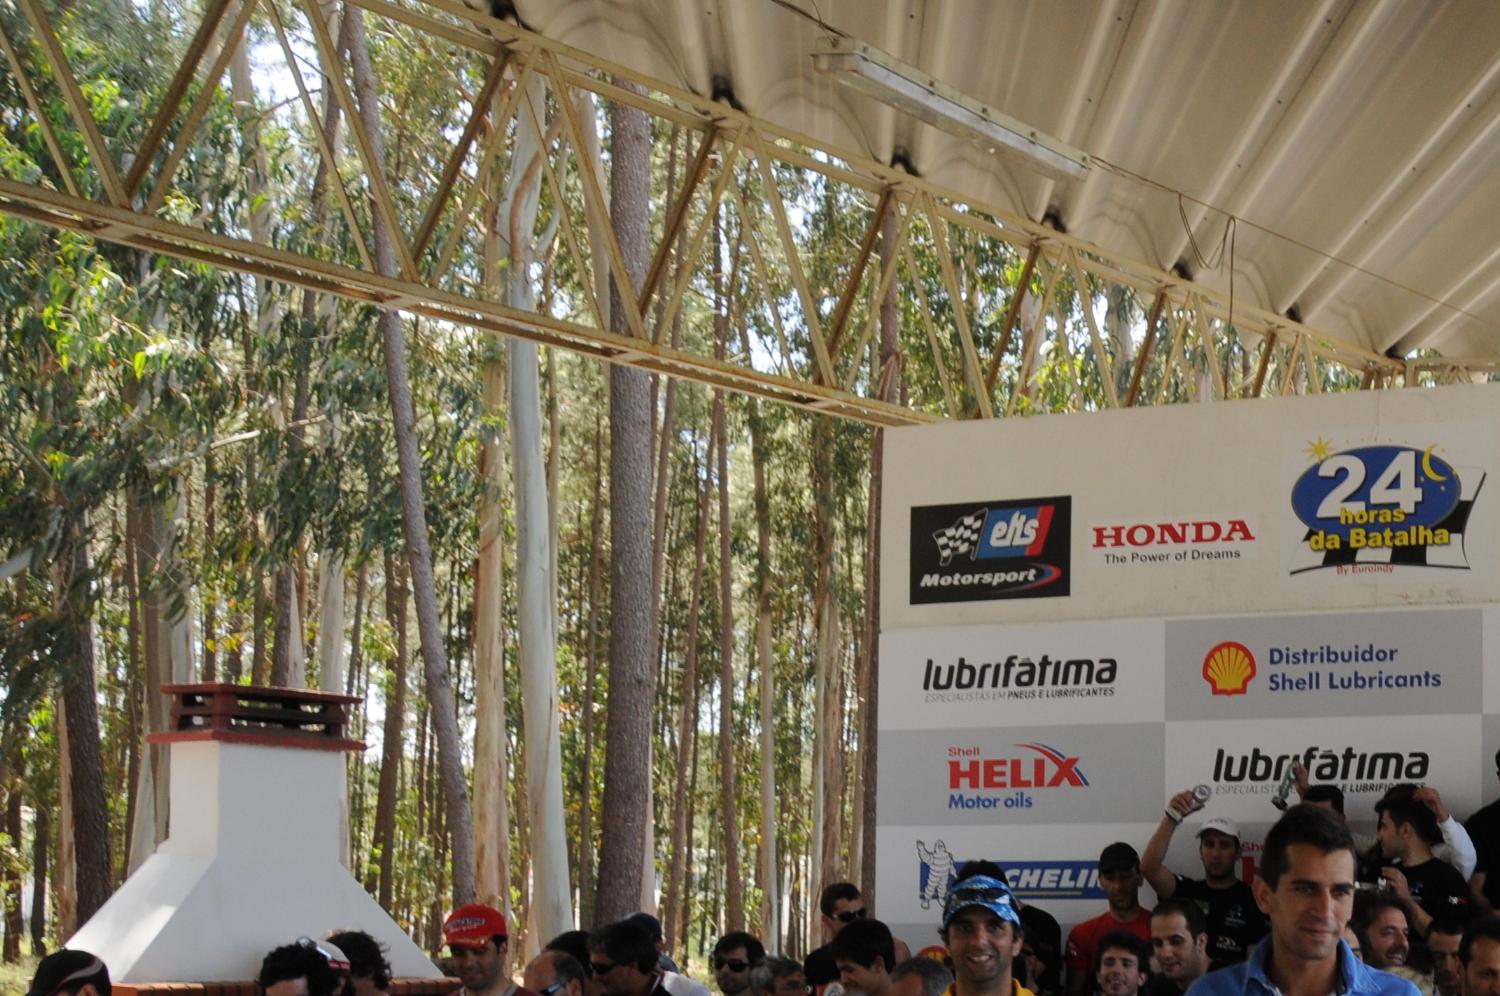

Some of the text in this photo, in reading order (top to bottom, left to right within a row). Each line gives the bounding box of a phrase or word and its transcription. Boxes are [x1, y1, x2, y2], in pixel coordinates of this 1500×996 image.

[1316, 451, 1424, 518] 24
[1339, 506, 1406, 525] horas
[1092, 519, 1255, 548] HONDA
[1309, 525, 1451, 549] da Batalha
[1104, 548, 1241, 564] The Power of Dreams
[920, 566, 1037, 588] Motorsport
[1268, 644, 1399, 665] Distribuidor
[1268, 669, 1442, 692] Shell Lubricants
[1007, 689, 1036, 699] PNEUS
[1046, 687, 1115, 698] LUBRIFICANTES
[949, 746, 980, 757] Shell
[949, 757, 1090, 788] HELIX
[949, 792, 1033, 809] Motor oils
